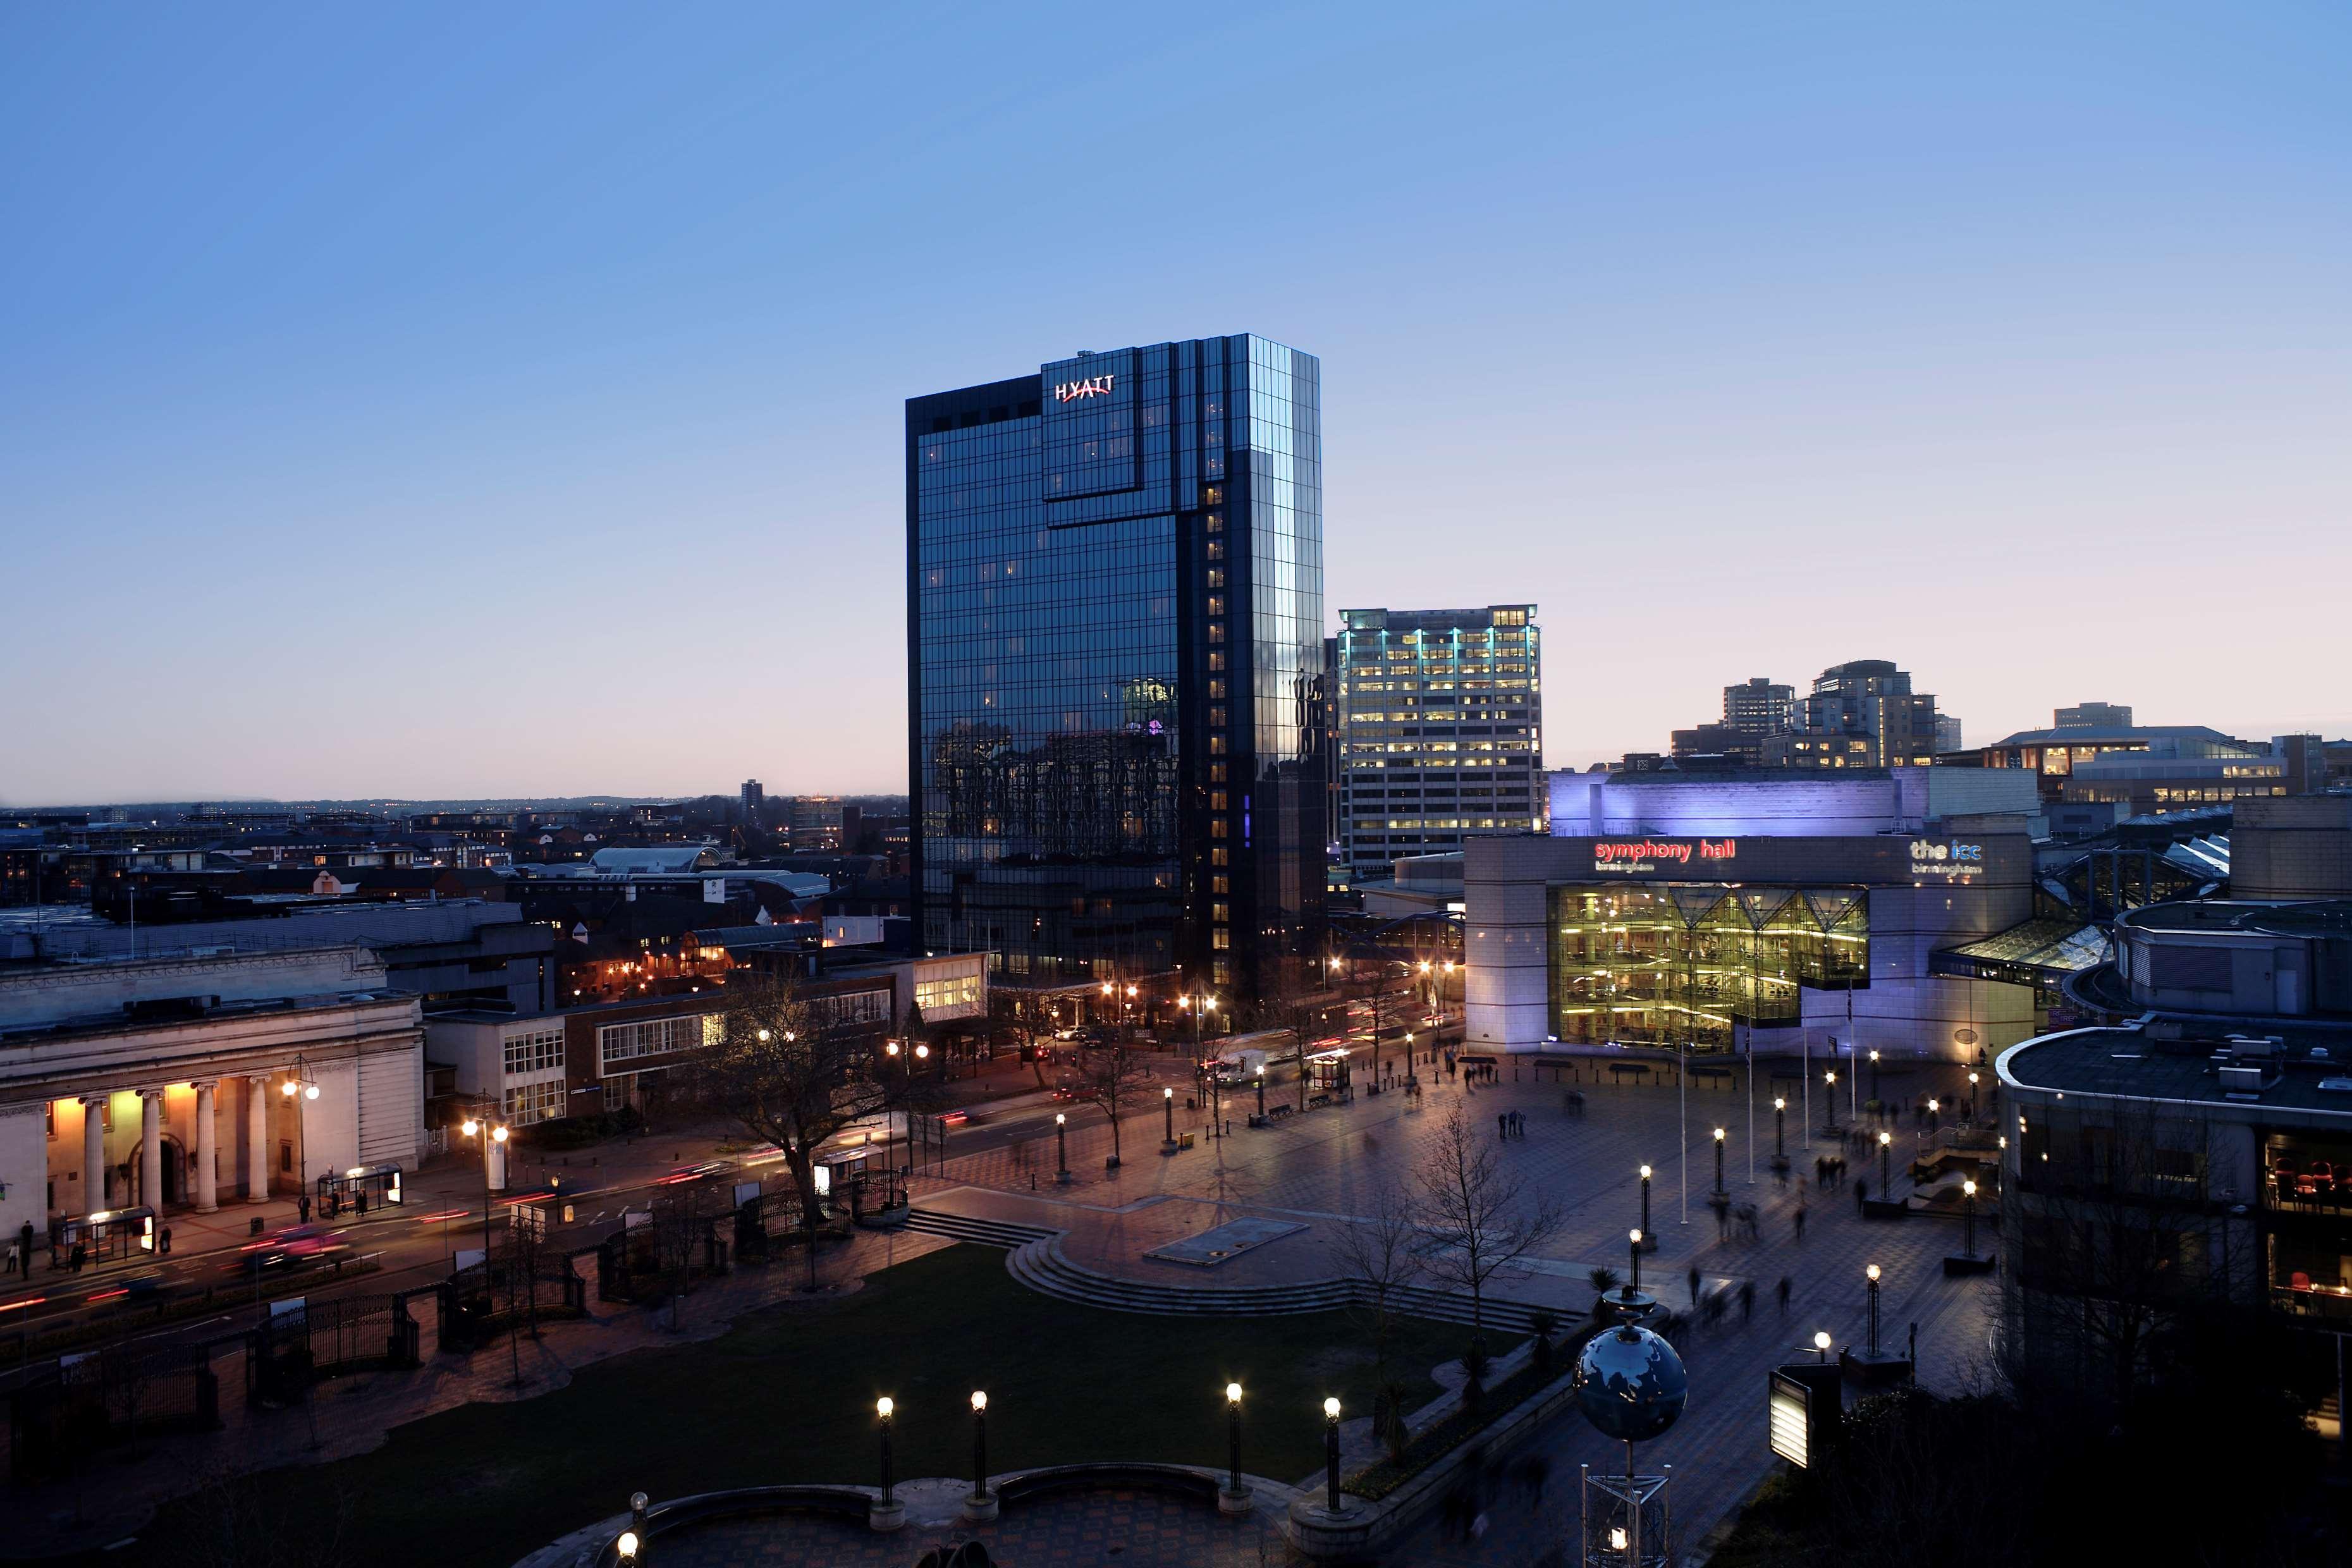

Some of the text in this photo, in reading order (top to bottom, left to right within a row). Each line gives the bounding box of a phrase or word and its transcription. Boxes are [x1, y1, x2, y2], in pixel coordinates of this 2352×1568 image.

[1055, 375, 1114, 400] HYATT
[1595, 839, 1735, 862] symphony hall
[1910, 840, 1982, 860] the icc
[1595, 861, 1654, 873] birmingham
[1912, 862, 1982, 876] birmingham
